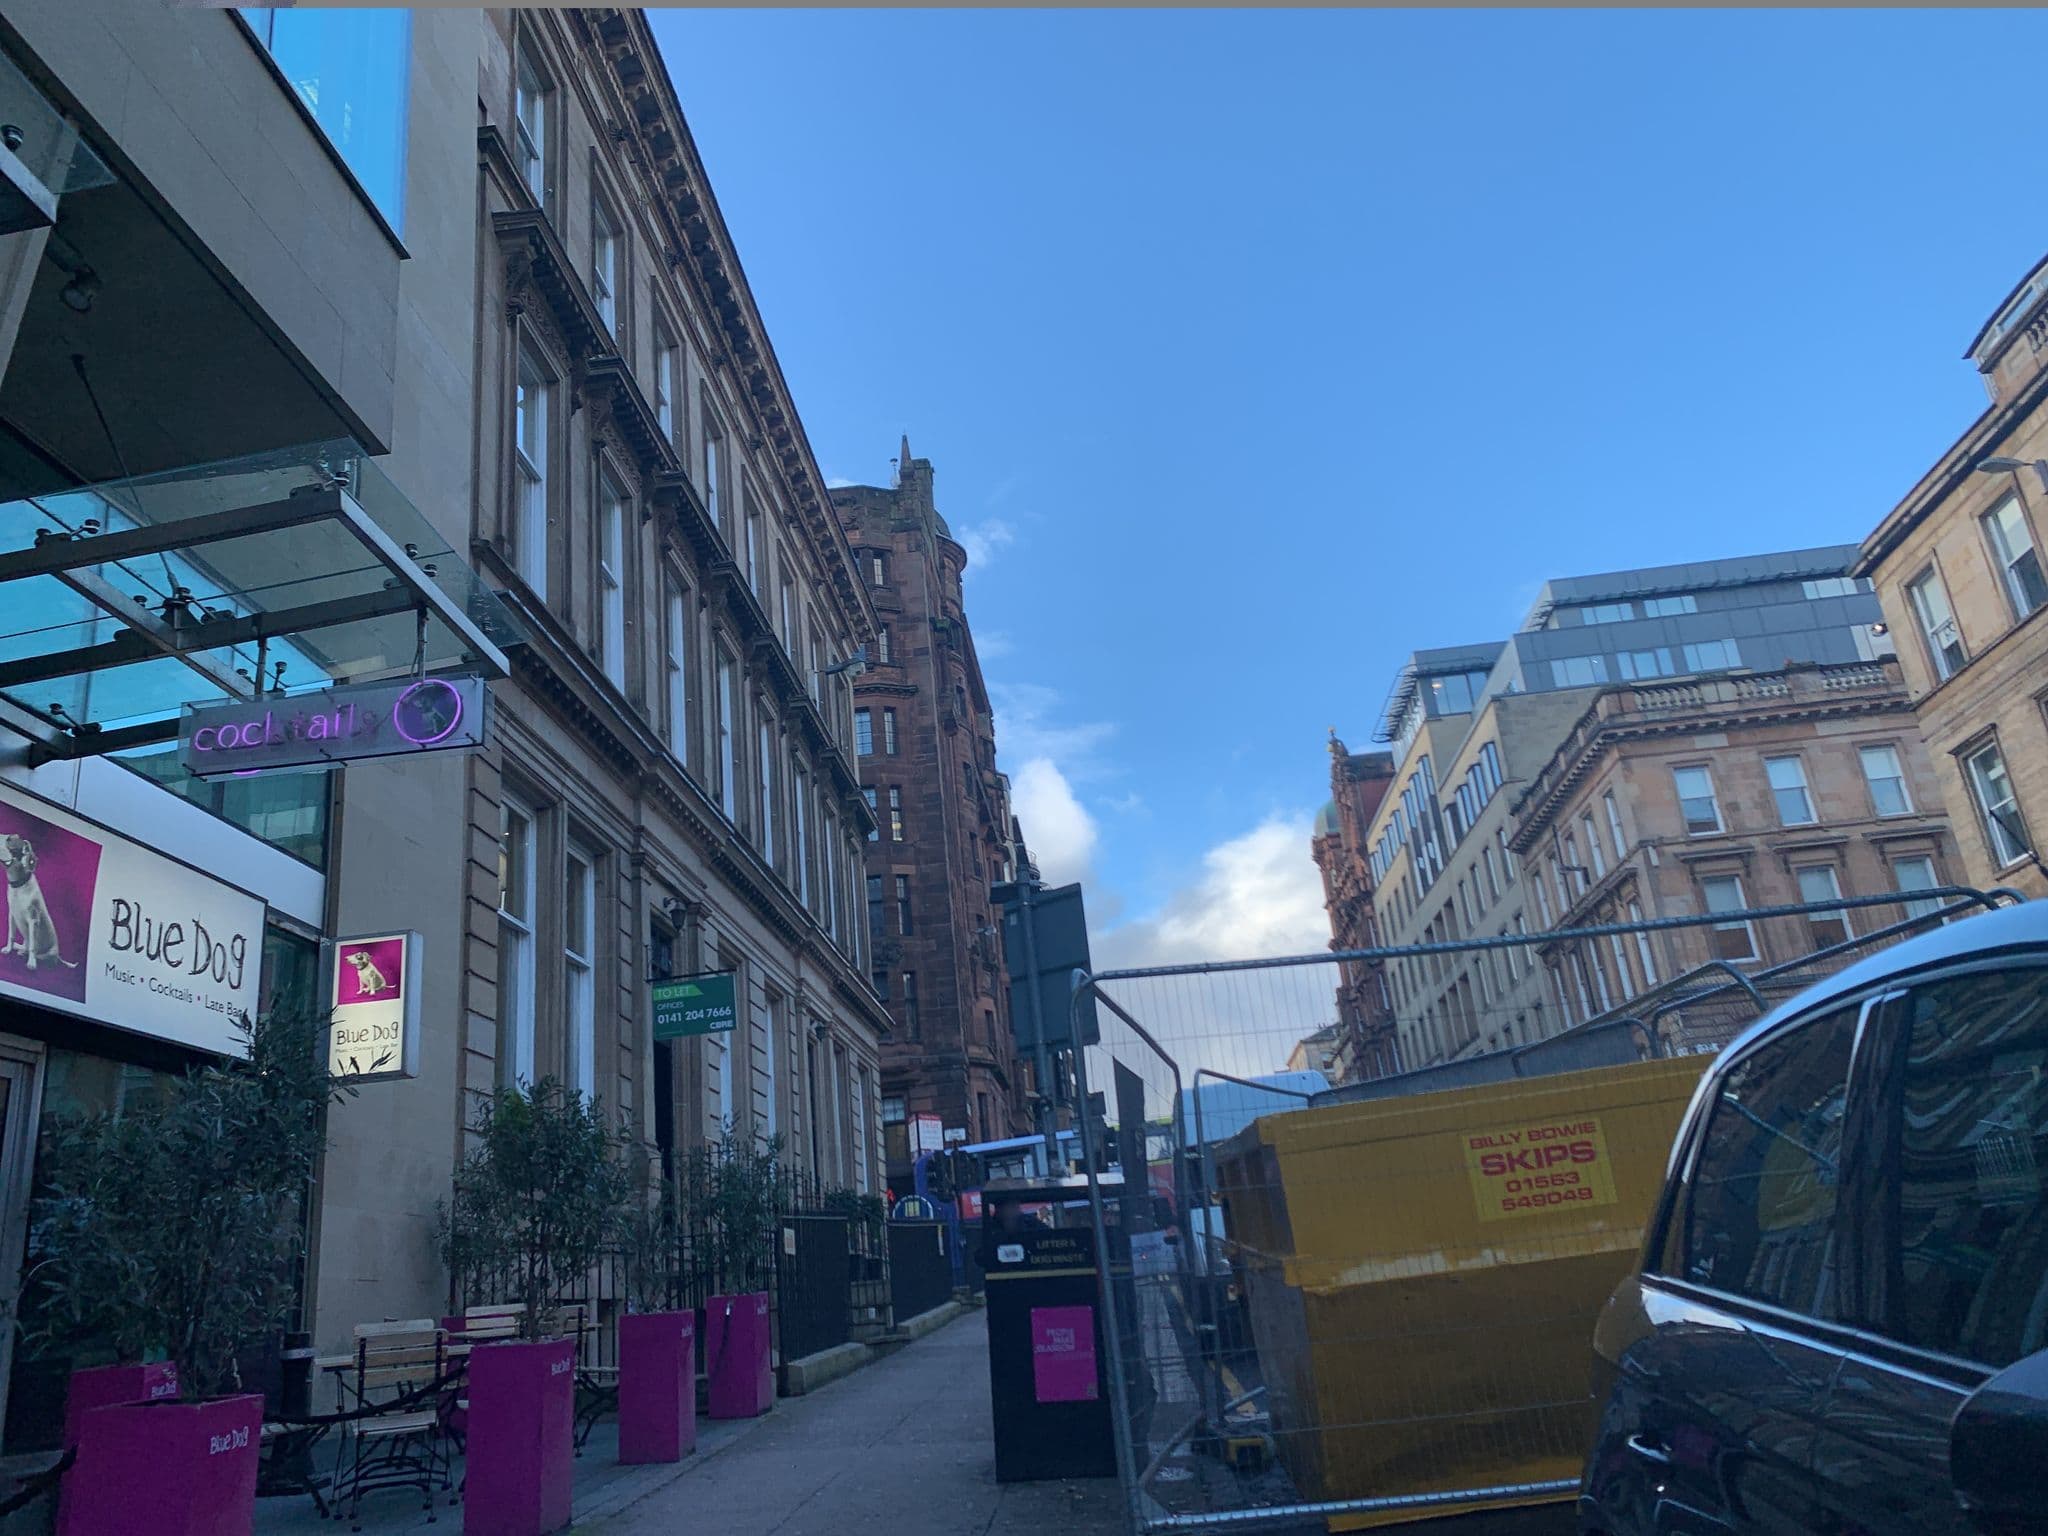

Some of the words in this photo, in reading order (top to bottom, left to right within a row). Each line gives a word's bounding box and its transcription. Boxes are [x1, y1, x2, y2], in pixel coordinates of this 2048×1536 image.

[109, 898, 185, 968] Blue
[188, 916, 248, 990] Dog
[105, 962, 136, 986] Music
[149, 977, 193, 1003] Cocktails
[205, 994, 225, 1013] Late
[657, 988, 671, 998] TO
[674, 986, 689, 997] LET
[657, 1001, 684, 1011] OFFICES
[657, 1012, 682, 1024] 0141
[685, 1009, 704, 1021] 204
[706, 1006, 732, 1018] 7666
[336, 1028, 369, 1045] Blue
[372, 1021, 399, 1041] Dog
[709, 1020, 734, 1030] CBRE
[1469, 1131, 1521, 1150] BILLY
[1527, 1122, 1596, 1142] BOWIE
[1480, 1140, 1597, 1176] SKIPS
[1501, 1187, 1593, 1211] 549049
[210, 1433, 231, 1454] Blue
[231, 1426, 249, 1449] Dog
